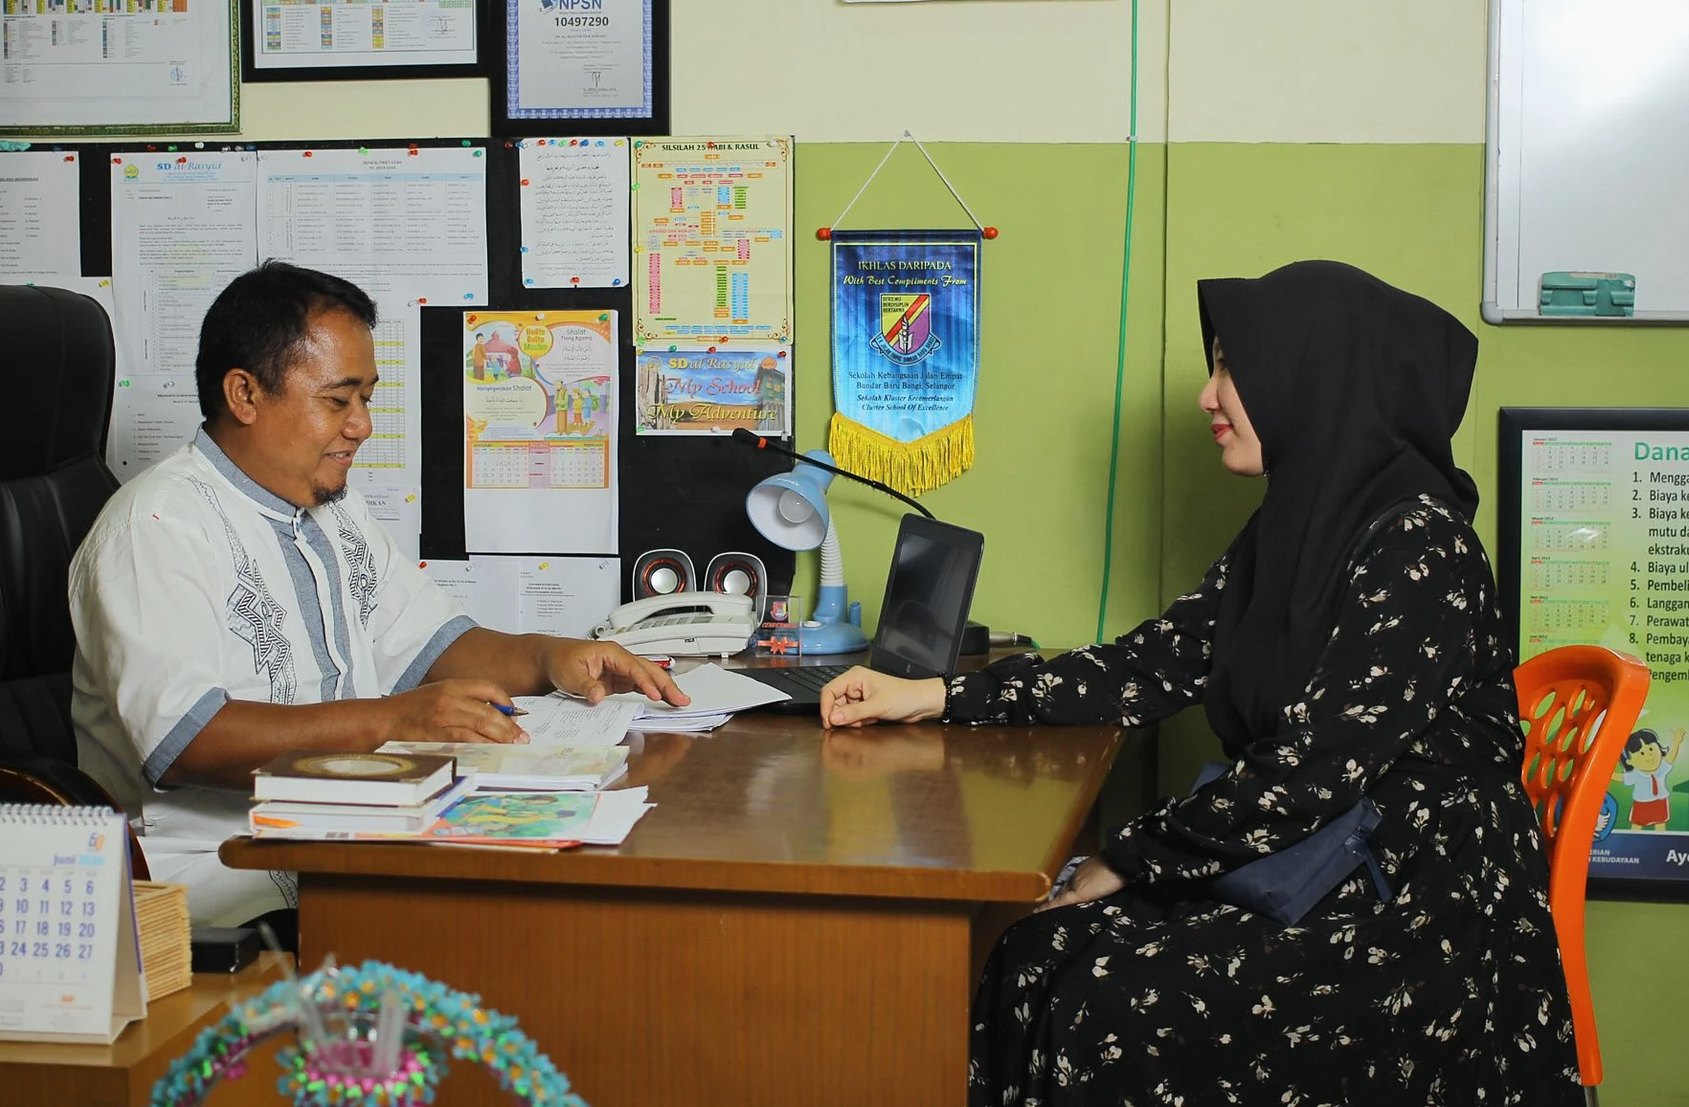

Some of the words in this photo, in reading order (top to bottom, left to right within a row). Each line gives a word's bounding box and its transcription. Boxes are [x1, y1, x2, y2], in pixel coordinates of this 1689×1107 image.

[560, 0, 601, 9] NPSN
[555, 17, 609, 26] 10497290
[858, 261, 896, 270] IKHLAS
[899, 261, 951, 270] DARIPADA
[843, 275, 864, 285] With
[867, 275, 884, 285] Best
[941, 275, 967, 287] From
[668, 358, 688, 369] SD
[848, 371, 876, 379] Sekolah
[878, 371, 919, 381] Kebangsaan
[940, 371, 963, 381] Empat
[663, 378, 703, 399] My
[705, 377, 761, 396] School
[925, 382, 955, 391] Selangor
[646, 403, 685, 423] My
[689, 402, 777, 421] Adventure
[907, 404, 916, 412] Of
[1634, 441, 1689, 461] Dana
[1632, 472, 1642, 482] 1.
[1632, 490, 1642, 500] 2.
[1649, 490, 1678, 504] Biaya
[1631, 509, 1641, 519] 3.
[1649, 508, 1677, 522] Biaya
[1648, 527, 1677, 537] mutu
[1630, 561, 1640, 573] 4.
[1648, 561, 1676, 576] Biaya
[1630, 579, 1640, 591] 5.
[1629, 597, 1640, 608] 6.
[1629, 615, 1639, 626] 7.
[1629, 632, 1639, 644] 8.
[1646, 633, 1689, 647] Pembay
[1645, 651, 1682, 665] tenaga
[1649, 669, 1689, 683] engem
[1592, 856, 1640, 864] KEBUDAYAAN
[20, 877, 28, 892] 3
[42, 879, 50, 893] 4
[64, 880, 72, 894] 5
[86, 880, 94, 895] 6
[16, 899, 28, 913] 10
[40, 899, 49, 914] 11
[60, 901, 73, 915] 12
[82, 902, 95, 916] 13
[15, 920, 26, 934] 17
[37, 921, 49, 935] 18
[58, 922, 71, 936] 19
[79, 923, 95, 938] 20
[11, 942, 26, 956] 24
[33, 943, 49, 957] 25
[55, 944, 71, 958] 26
[78, 945, 93, 959] 27
